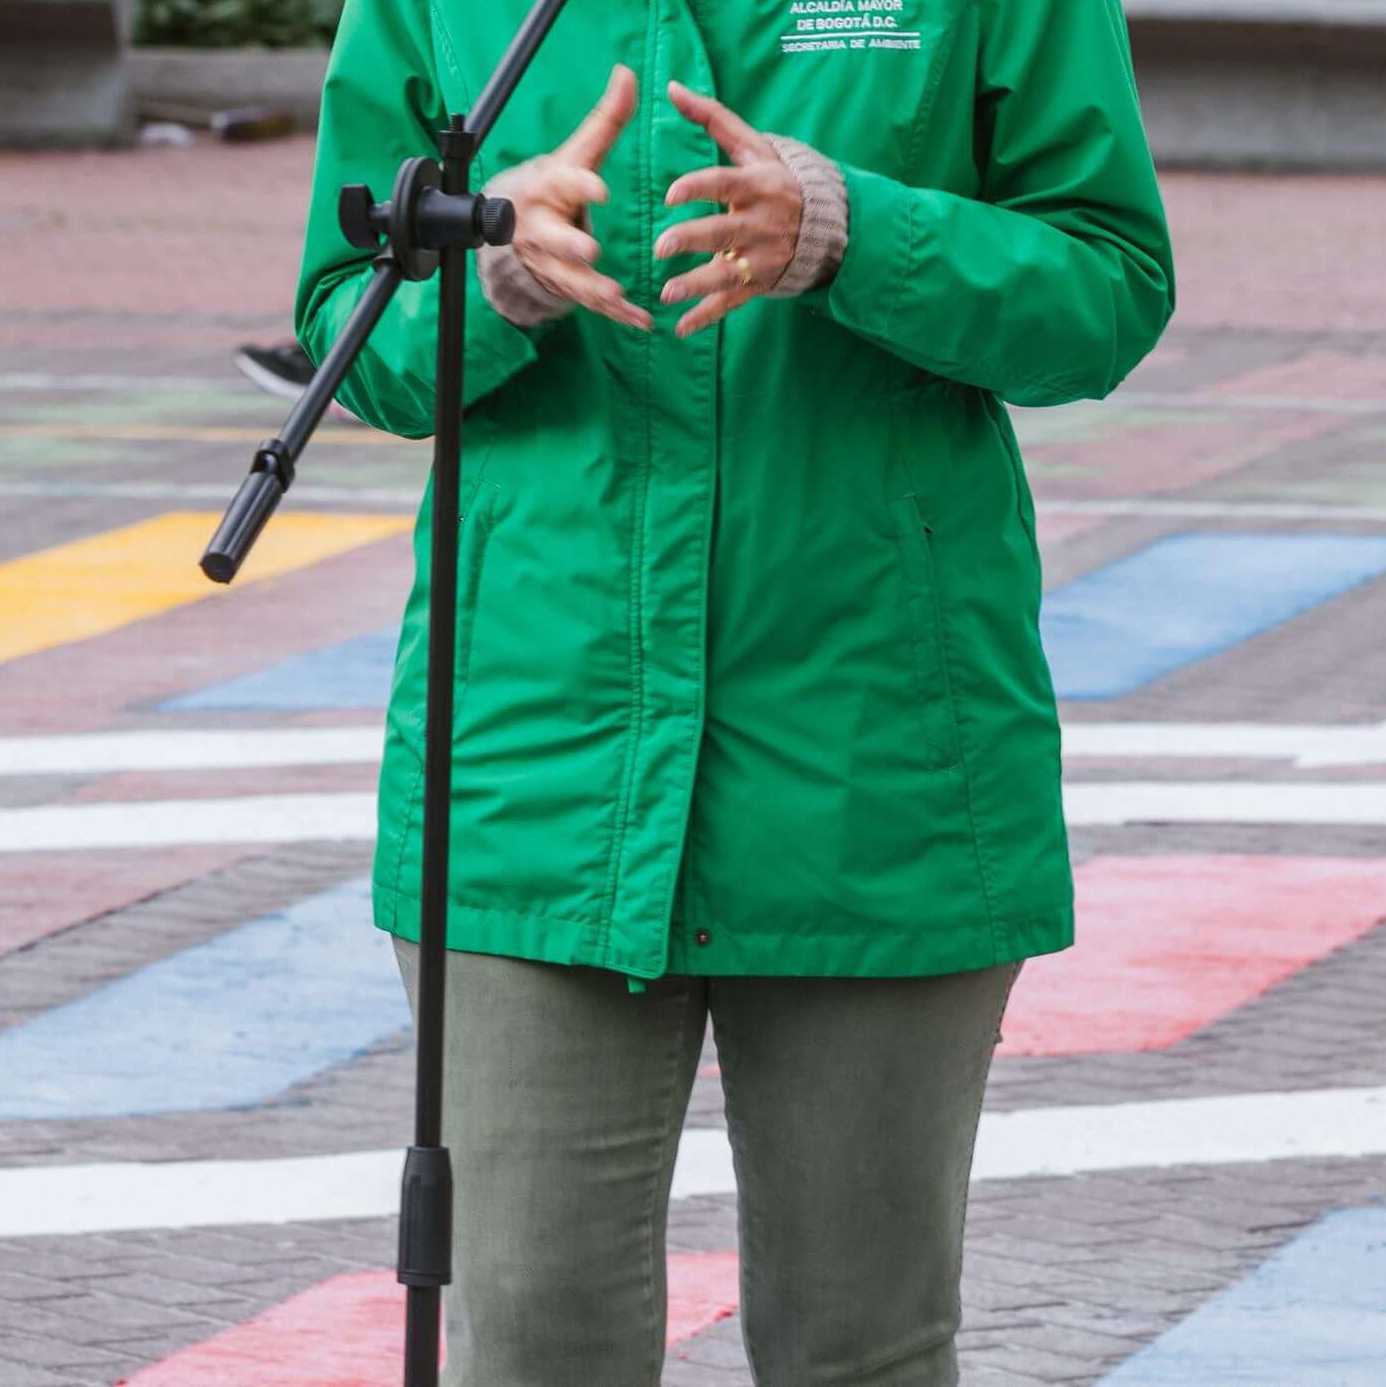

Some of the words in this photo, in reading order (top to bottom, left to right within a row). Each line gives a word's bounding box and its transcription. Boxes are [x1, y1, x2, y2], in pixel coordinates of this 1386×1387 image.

[857, 0, 903, 12] MAYOR
[796, 19, 814, 31] DE
[815, 12, 871, 29] BOGOTÁ
[873, 16, 899, 28] D.C.
[850, 39, 865, 49] DE
